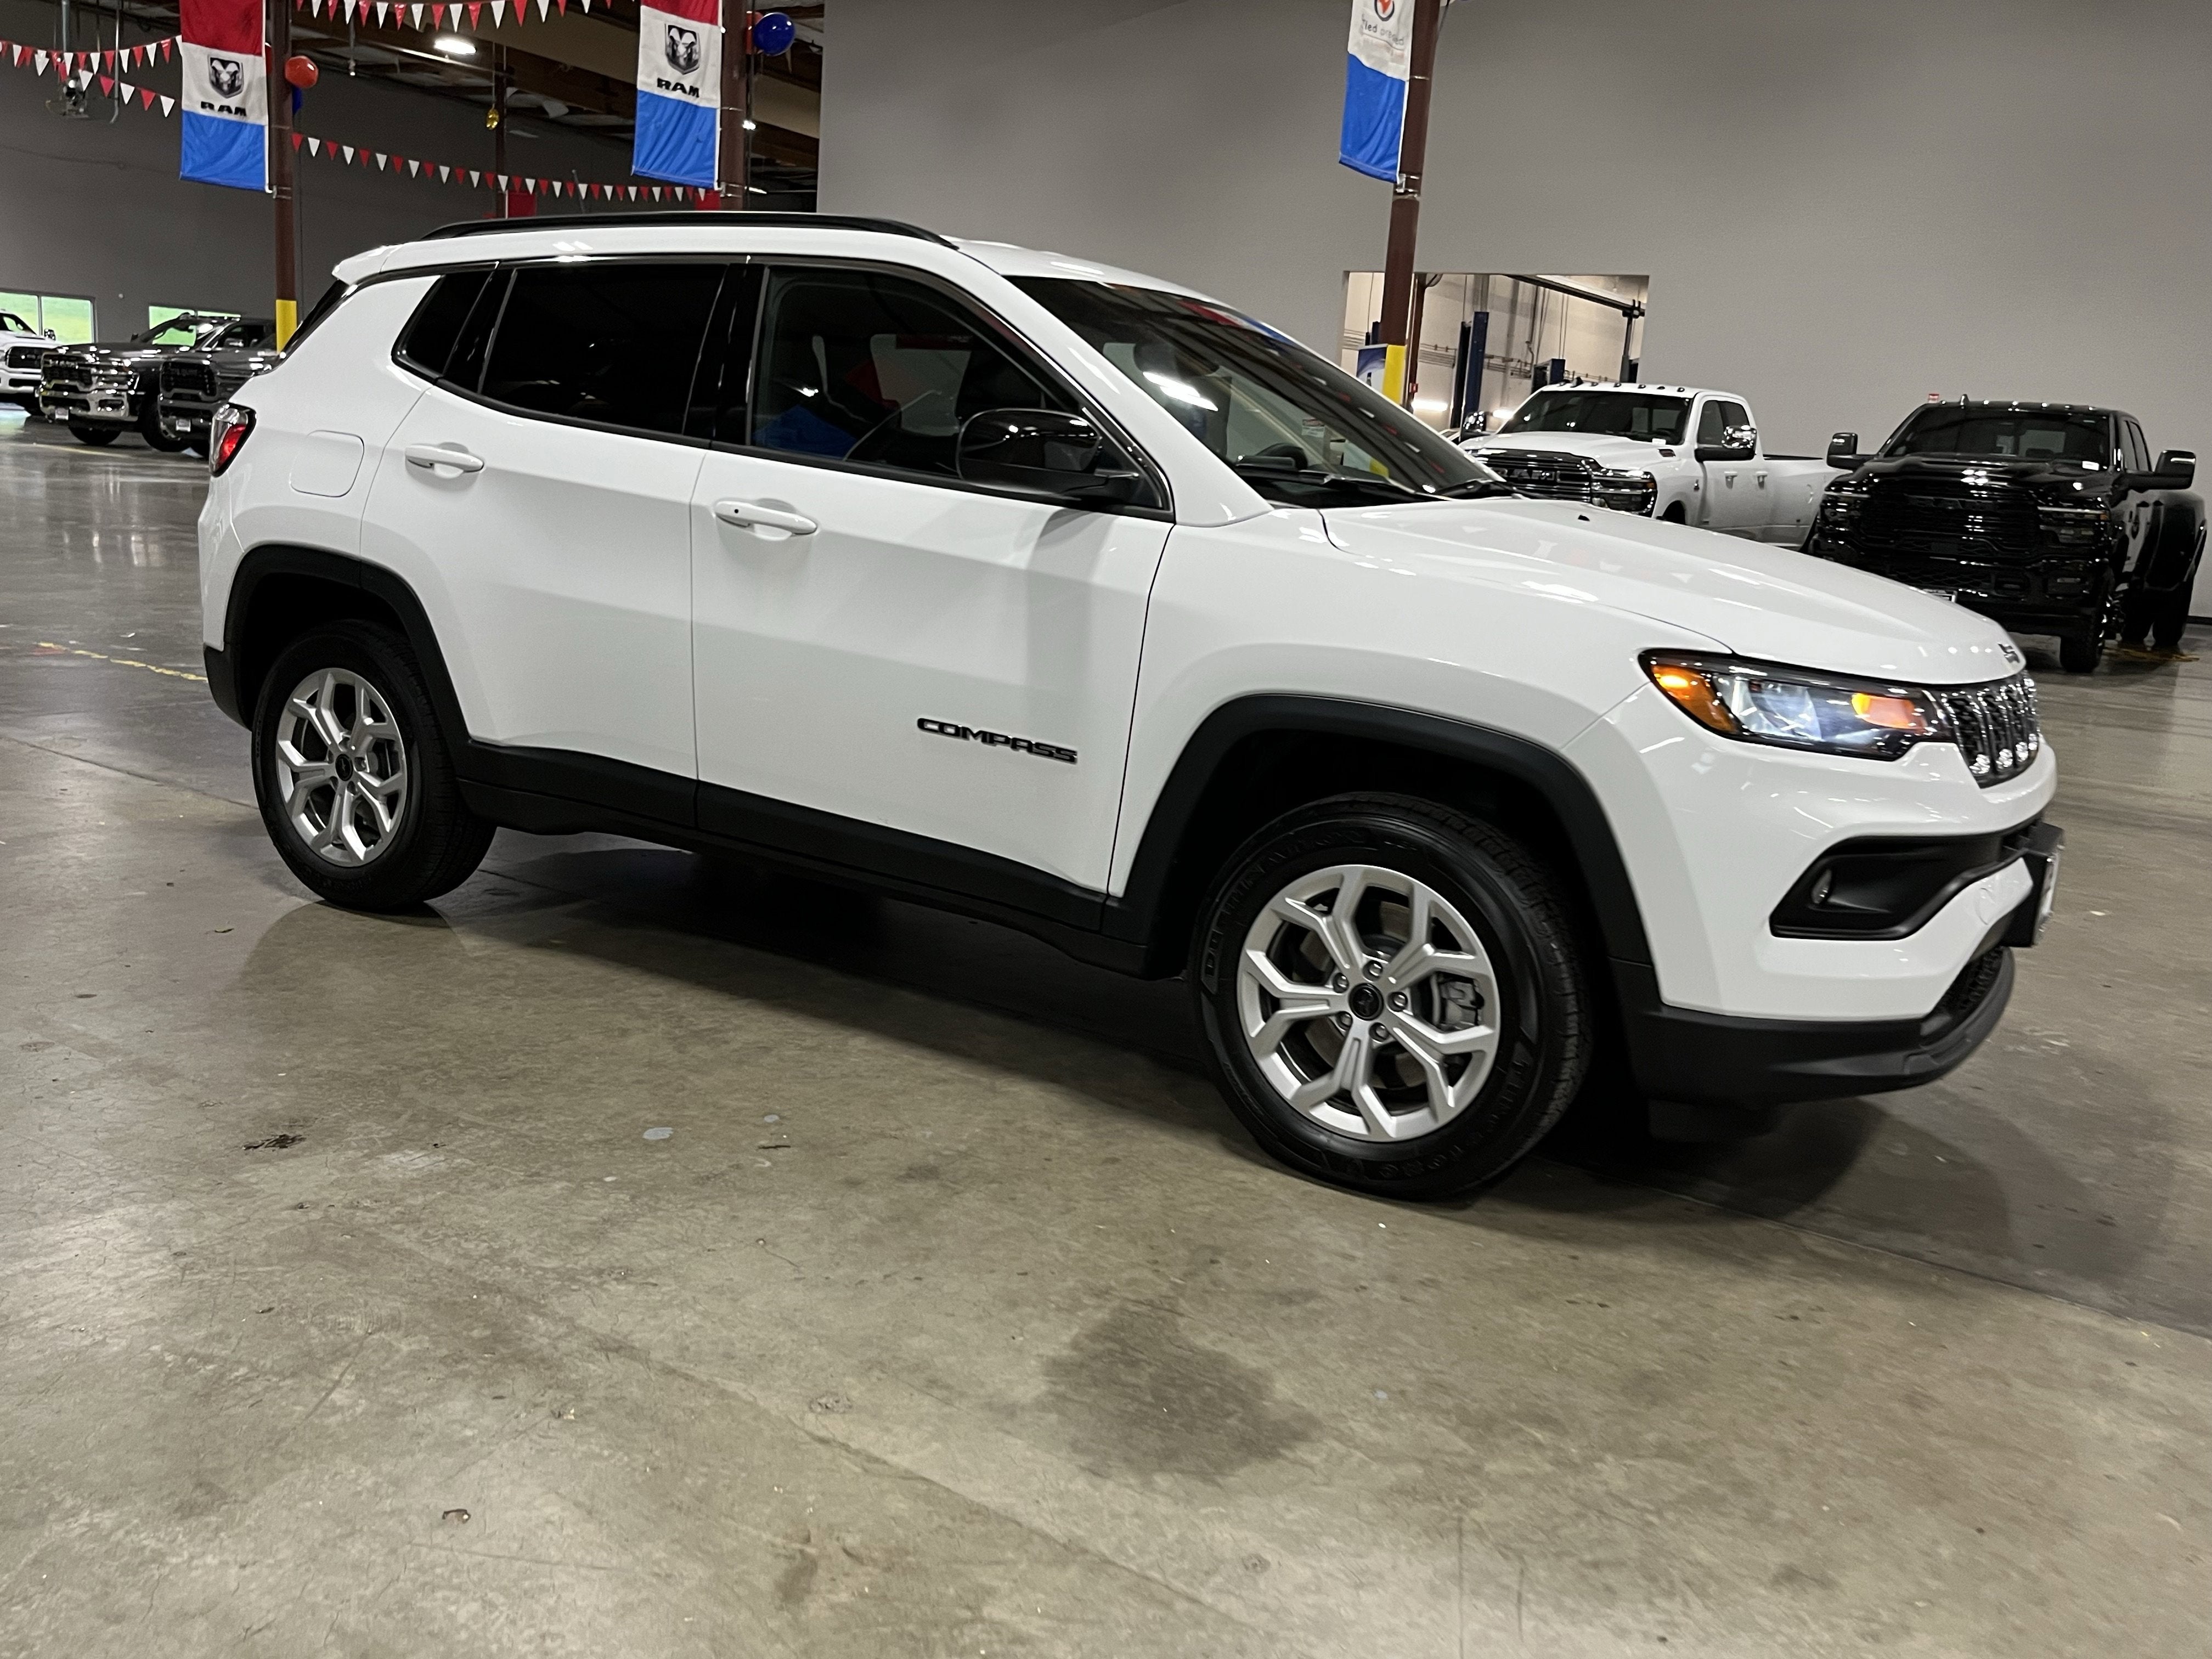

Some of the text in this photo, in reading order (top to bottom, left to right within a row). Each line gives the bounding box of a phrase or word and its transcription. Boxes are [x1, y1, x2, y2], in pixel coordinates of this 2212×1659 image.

[657, 77, 699, 98] RAM
[200, 101, 247, 117] RAM
[917, 718, 1077, 764] COMPASS
